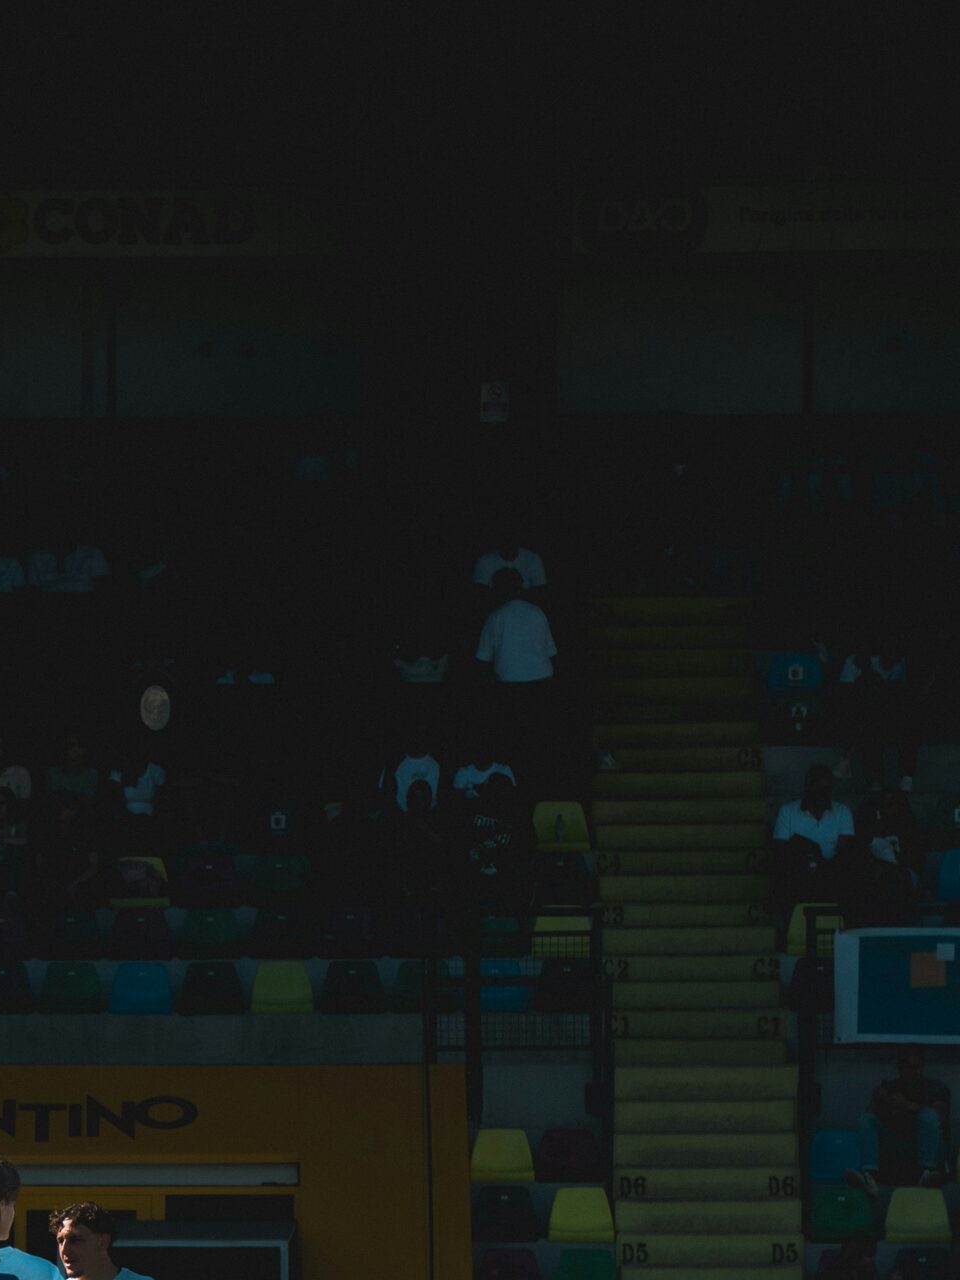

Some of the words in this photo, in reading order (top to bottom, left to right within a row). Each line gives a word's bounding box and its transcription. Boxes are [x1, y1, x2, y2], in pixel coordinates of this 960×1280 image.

[33, 196, 256, 245] CONAD
[603, 960, 629, 979] C2
[757, 1016, 780, 1037] C1
[620, 1175, 647, 1197] D6
[769, 1175, 795, 1197] D6
[622, 1243, 649, 1264] D5
[772, 1243, 799, 1264] D5
